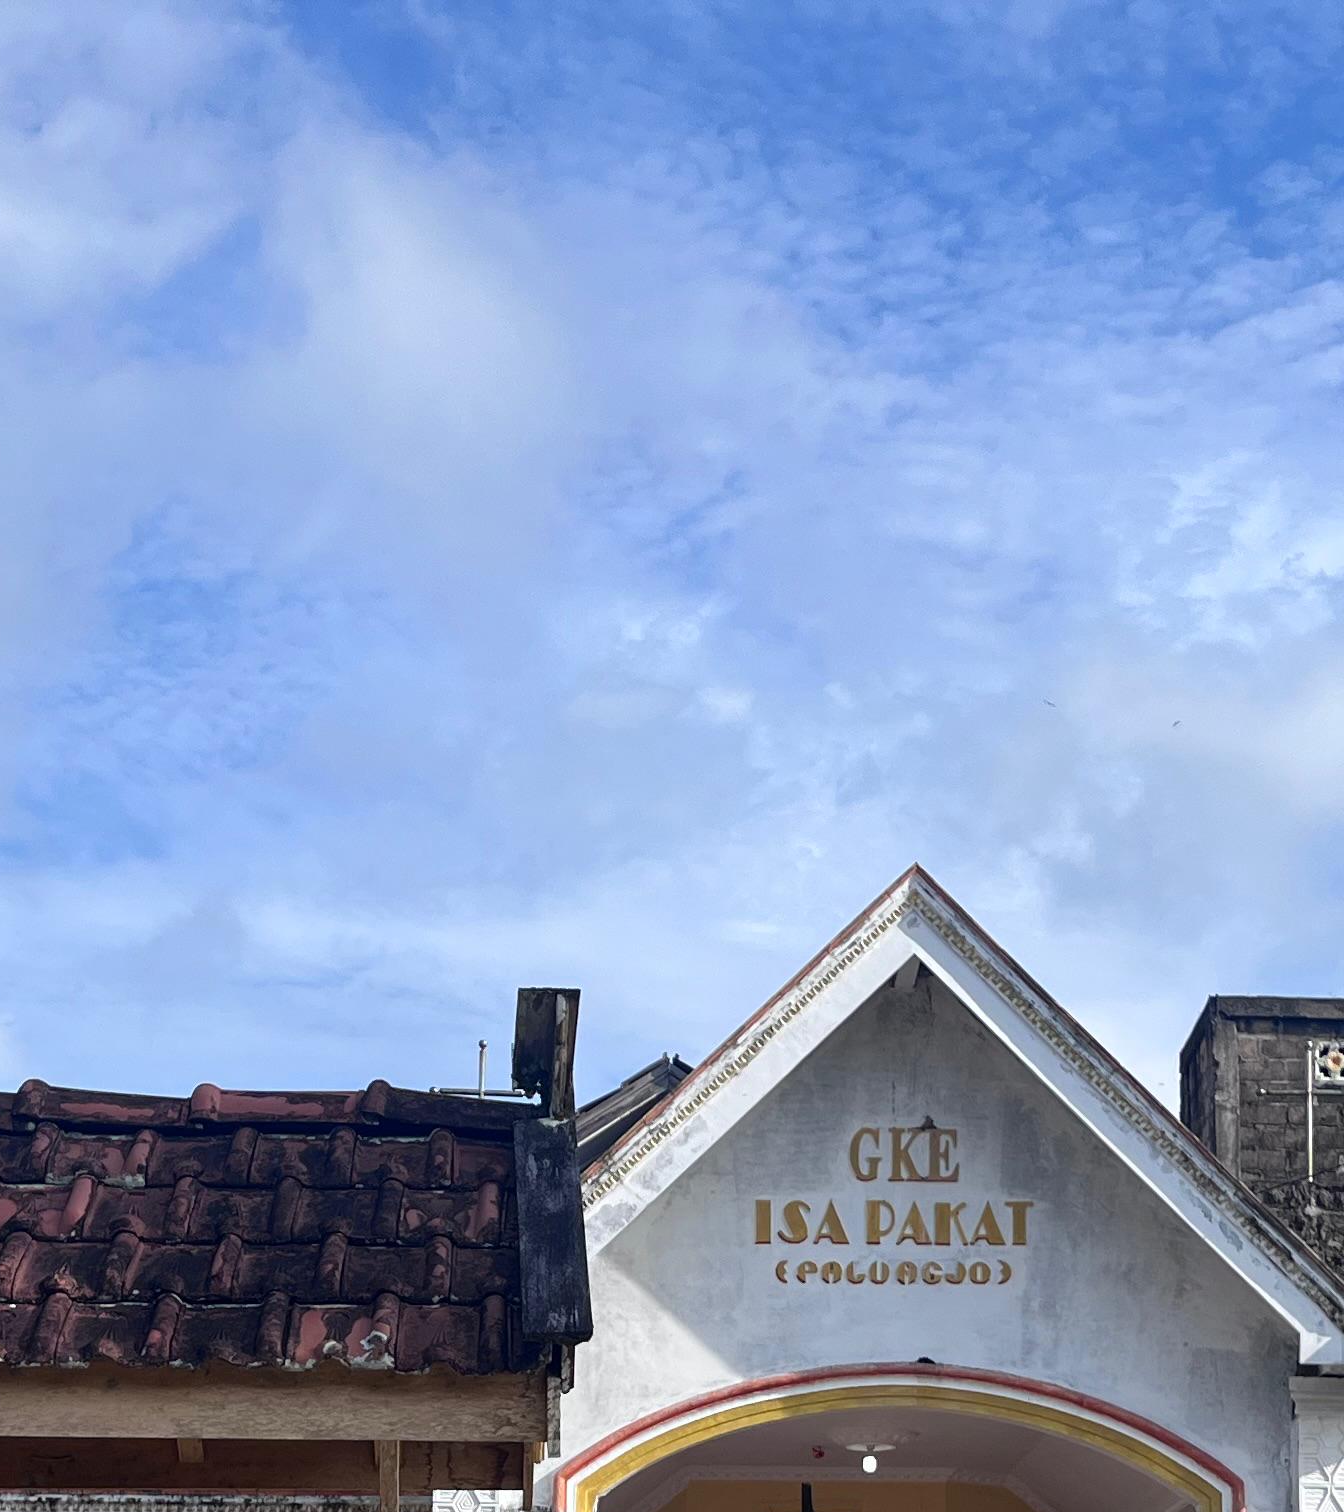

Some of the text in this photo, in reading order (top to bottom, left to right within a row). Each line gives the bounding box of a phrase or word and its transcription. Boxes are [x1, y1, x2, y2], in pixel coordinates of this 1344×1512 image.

[849, 1126, 960, 1183] GKE
[754, 1199, 1035, 1246] ISA PAKAT
